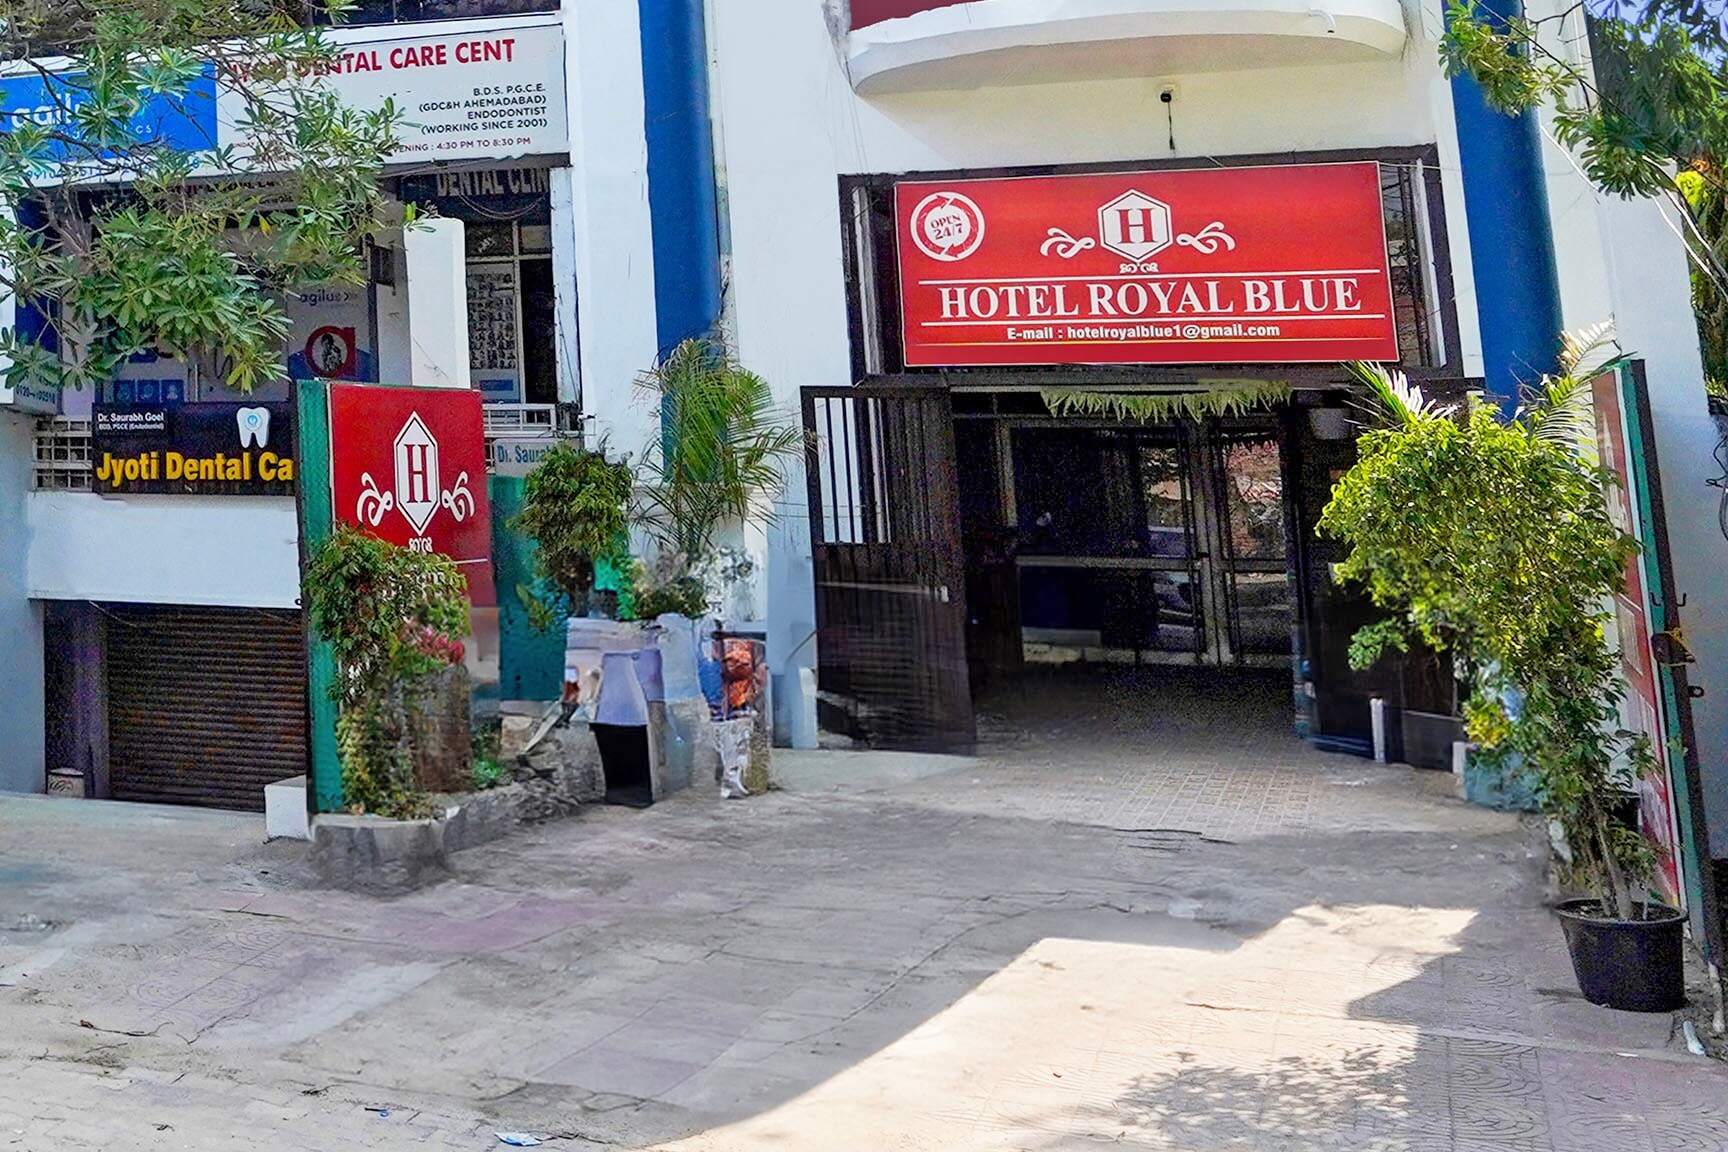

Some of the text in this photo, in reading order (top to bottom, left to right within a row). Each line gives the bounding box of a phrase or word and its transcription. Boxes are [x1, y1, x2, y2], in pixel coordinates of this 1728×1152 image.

[390, 44, 447, 72] CARE
[455, 38, 515, 64] CENT
[473, 83, 546, 97] B.D.S. P.G.C.E.
[418, 94, 547, 113] (GDC&H AHEMADABAD)
[467, 106, 547, 120] ENDODONTIST
[421, 117, 548, 135] (WORKING SINCE 2001)
[390, 143, 429, 153] VENING
[436, 141, 458, 150] 4:30
[460, 140, 474, 149] PM
[476, 139, 491, 148] TO
[516, 137, 531, 146] PM
[436, 170, 505, 197] DENTAL
[930, 214, 962, 230] OPEN
[1117, 208, 1160, 245] H
[932, 222, 964, 242] 24/7
[299, 289, 341, 306] agilus
[939, 278, 1362, 319] HOTEL ROYAL BLUE
[1007, 325, 1054, 341] E-mail
[1067, 323, 1281, 341] hotelroyalblue1@gmail.com
[96, 451, 160, 488] Jyoti
[165, 451, 251, 482] Dental
[403, 443, 432, 504] H
